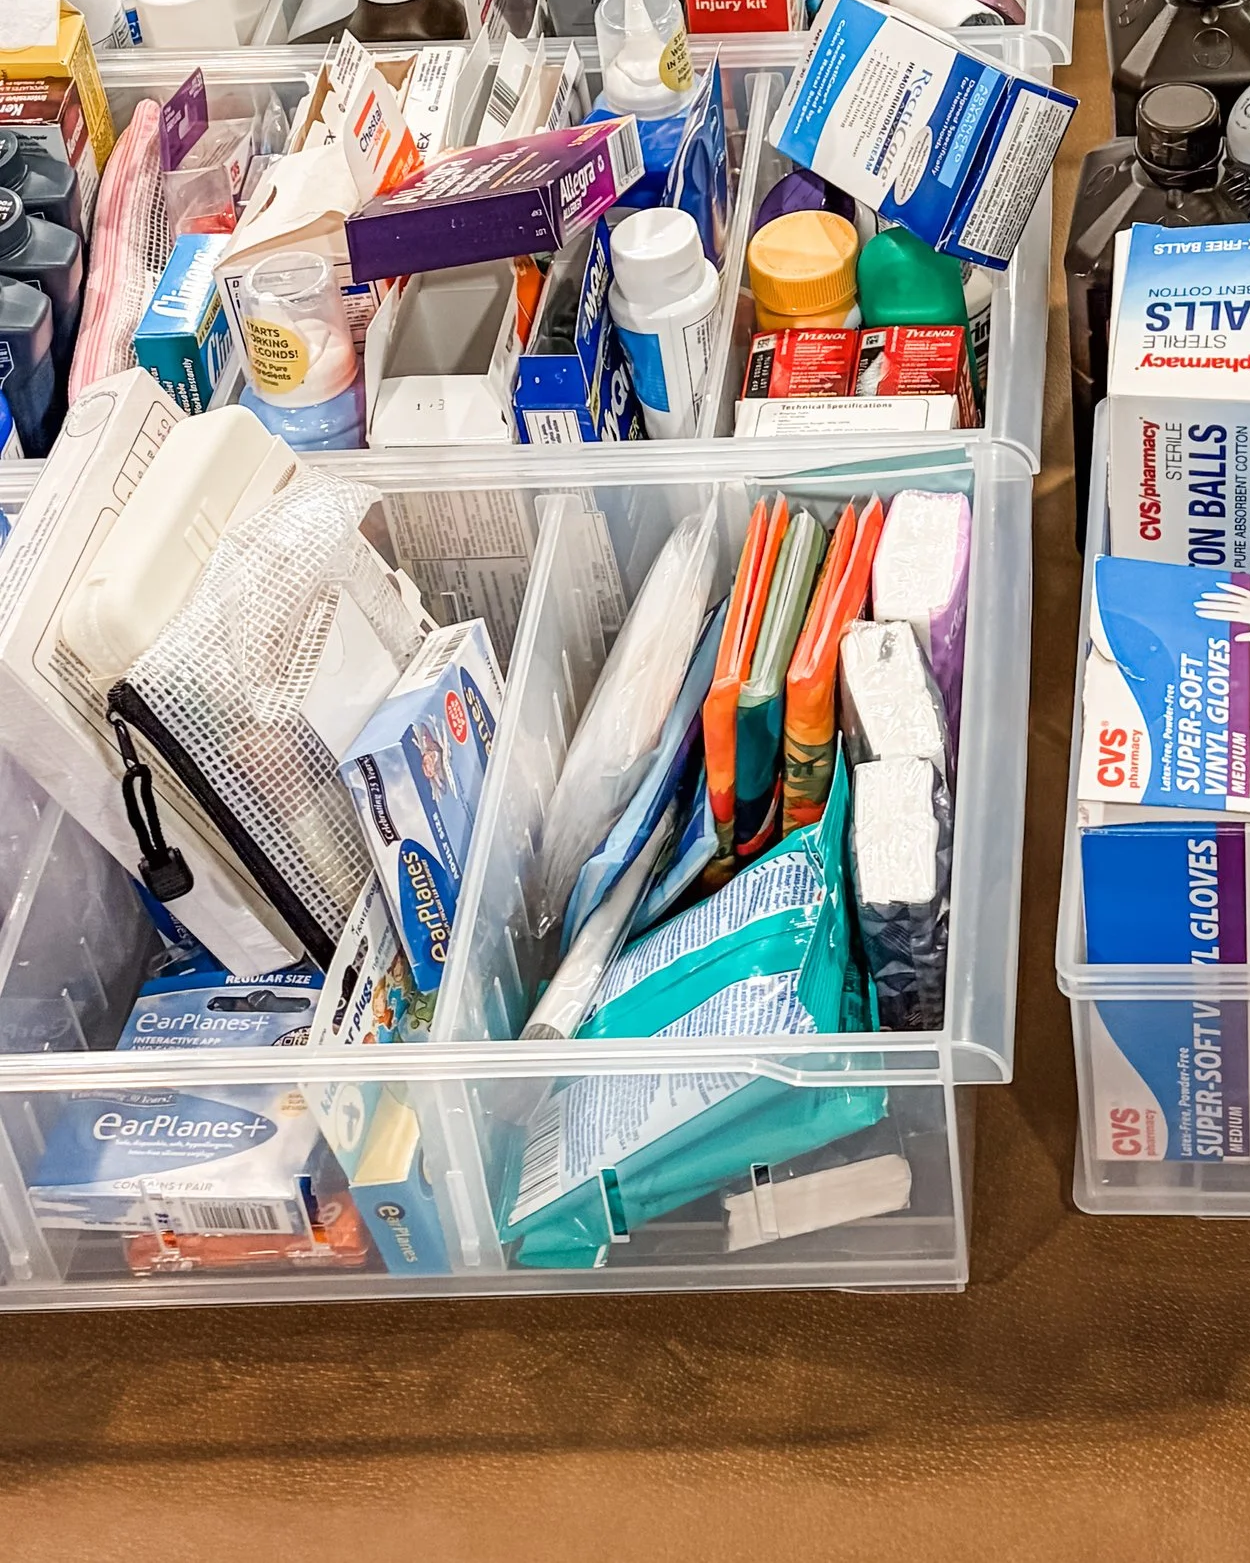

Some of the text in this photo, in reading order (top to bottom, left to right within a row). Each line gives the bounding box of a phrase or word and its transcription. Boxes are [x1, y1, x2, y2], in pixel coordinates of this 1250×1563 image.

[695, 0, 742, 12] injury
[359, 102, 383, 153] Chestal
[559, 161, 596, 208] Allegra
[1153, 241, 1201, 255] BALLS
[1147, 286, 1212, 298] COTTON
[797, 332, 847, 341] TYLENOL
[906, 328, 956, 338] TYLENOL
[1142, 335, 1228, 349] STERILE
[1165, 421, 1183, 481] STERILE
[1188, 423, 1228, 518] BALLS
[1233, 424, 1249, 569] PURE ABSORBENT COTTON
[1176, 653, 1204, 794] SUPER-SOFT
[1204, 637, 1230, 796] VINYL GLOVES
[1097, 728, 1128, 788] CVS
[1128, 729, 1143, 789] pharmacy
[1229, 732, 1247, 794] MEDIUM
[371, 790, 395, 841] Celebrating
[432, 812, 460, 880] ADULT SIZE
[1187, 838, 1219, 940] GLOVES
[224, 974, 312, 984] REGULAR SIZE
[352, 976, 373, 1029] plugs
[133, 1036, 222, 1046] INTERACTIVE APP
[1194, 1030, 1224, 1157] SUPER-SOFT
[1109, 1108, 1141, 1156] CVS
[1228, 1105, 1244, 1153] MEDIUM
[182, 1181, 213, 1192] PAIR
